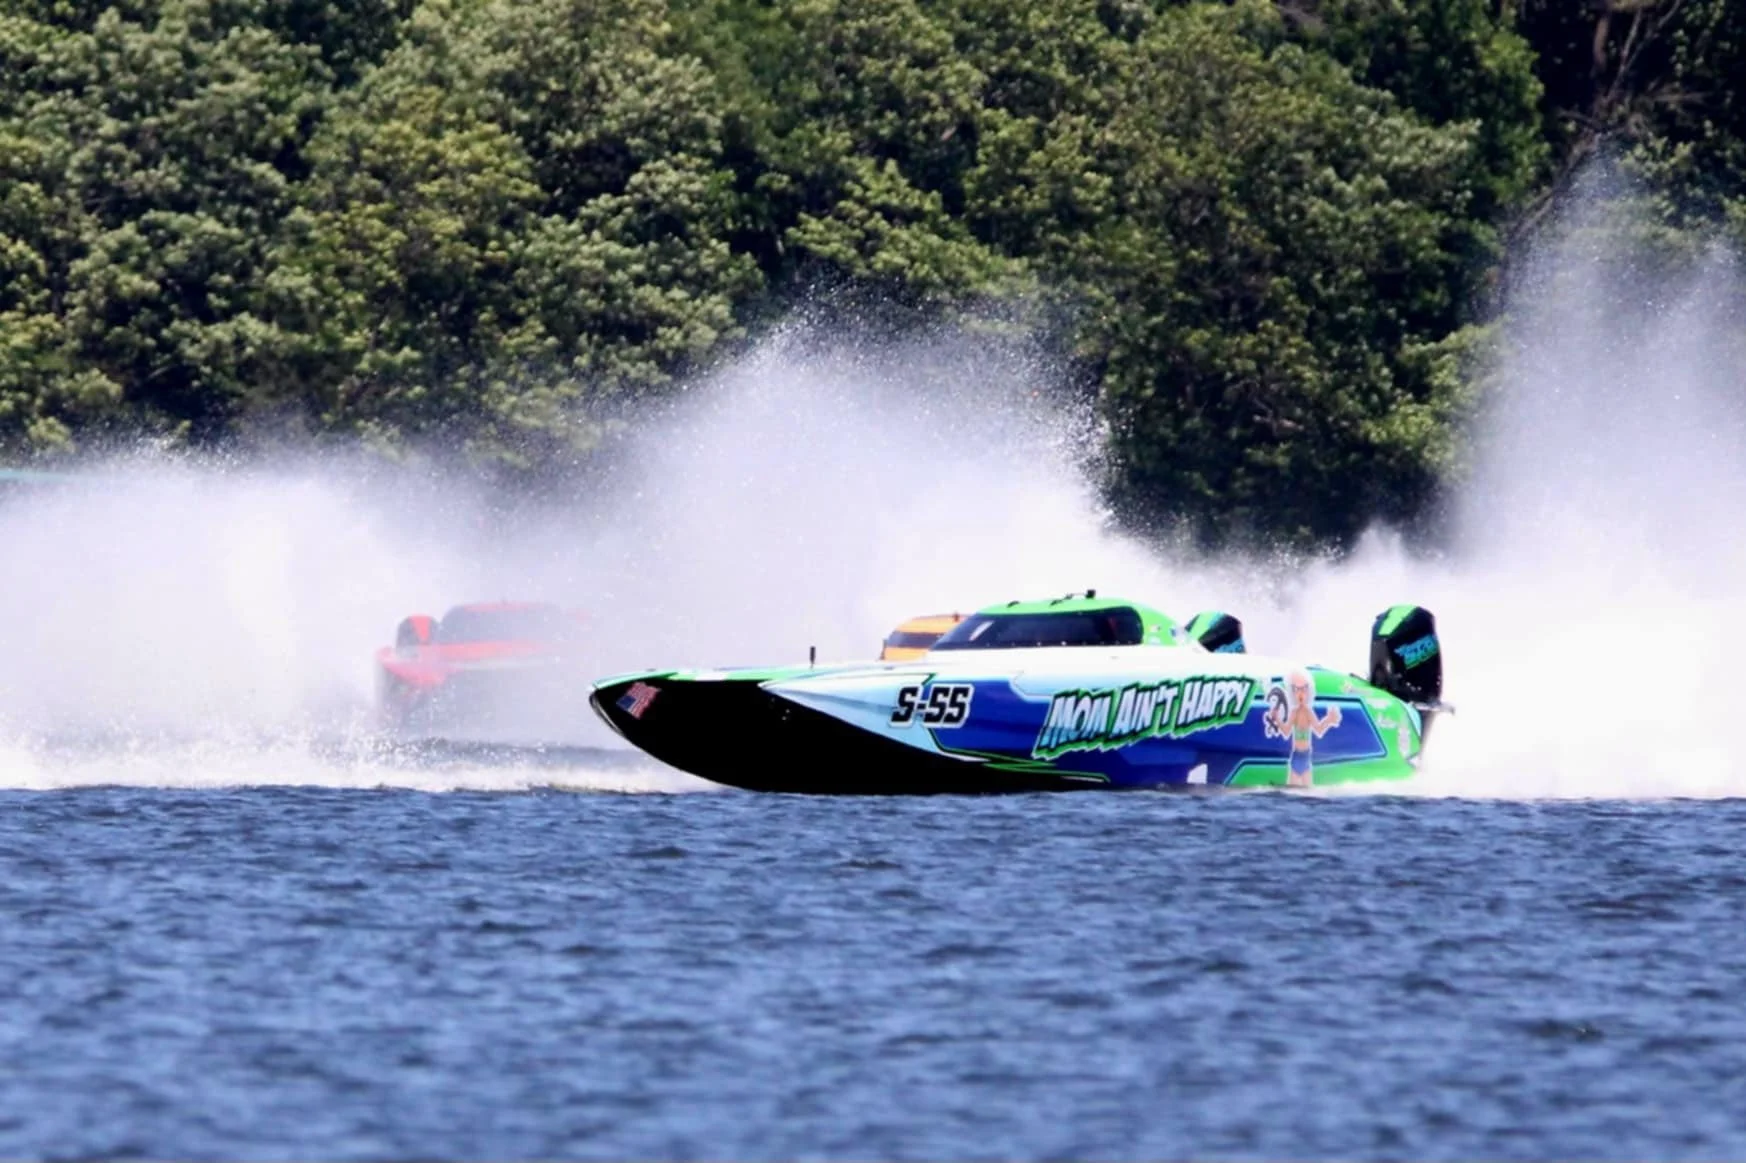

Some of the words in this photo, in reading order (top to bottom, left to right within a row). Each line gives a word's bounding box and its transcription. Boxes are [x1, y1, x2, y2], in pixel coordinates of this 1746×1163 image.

[1037, 693, 1113, 750] MOM
[1110, 683, 1179, 739] AIN'T
[1175, 678, 1251, 726] HAPPY
